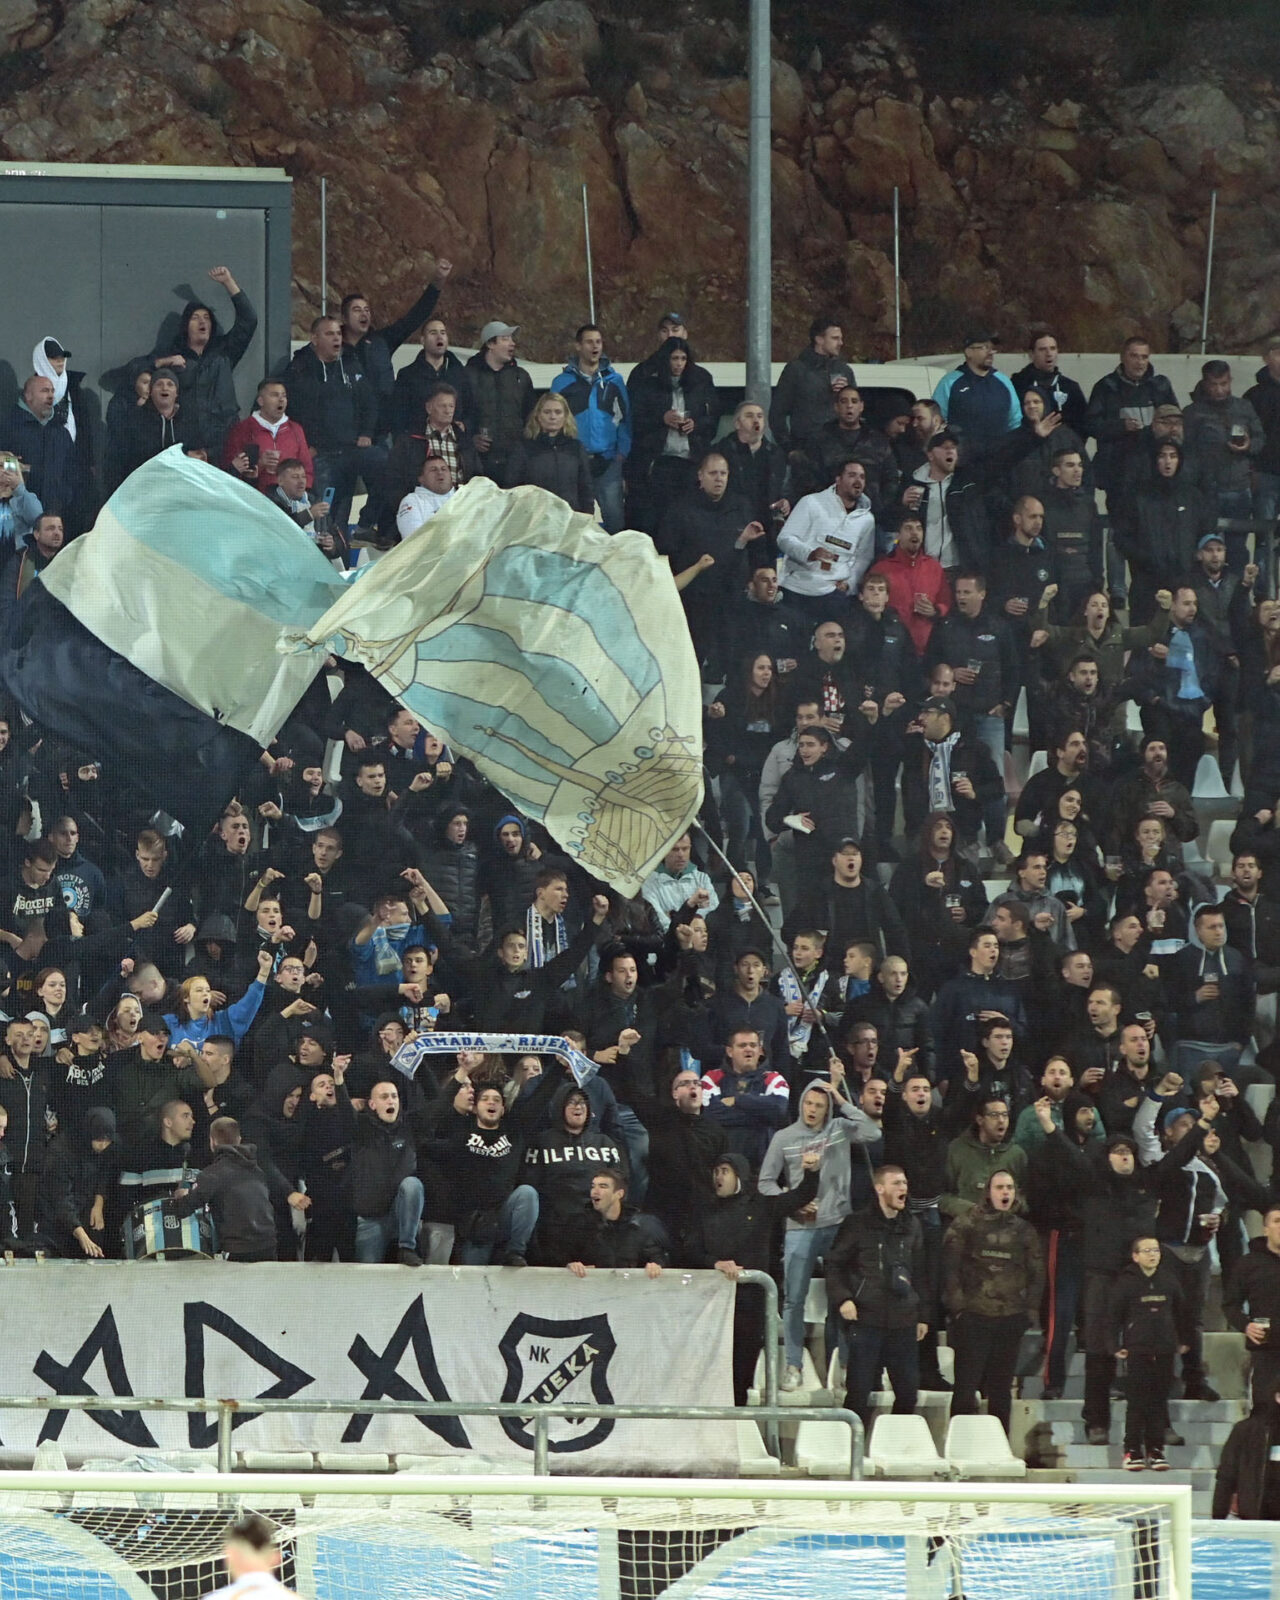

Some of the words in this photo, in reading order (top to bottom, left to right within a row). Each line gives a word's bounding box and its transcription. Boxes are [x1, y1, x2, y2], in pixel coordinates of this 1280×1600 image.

[414, 1036, 486, 1050] ARMADA
[518, 1037, 571, 1052] RIJEK
[529, 1345, 551, 1364] NK
